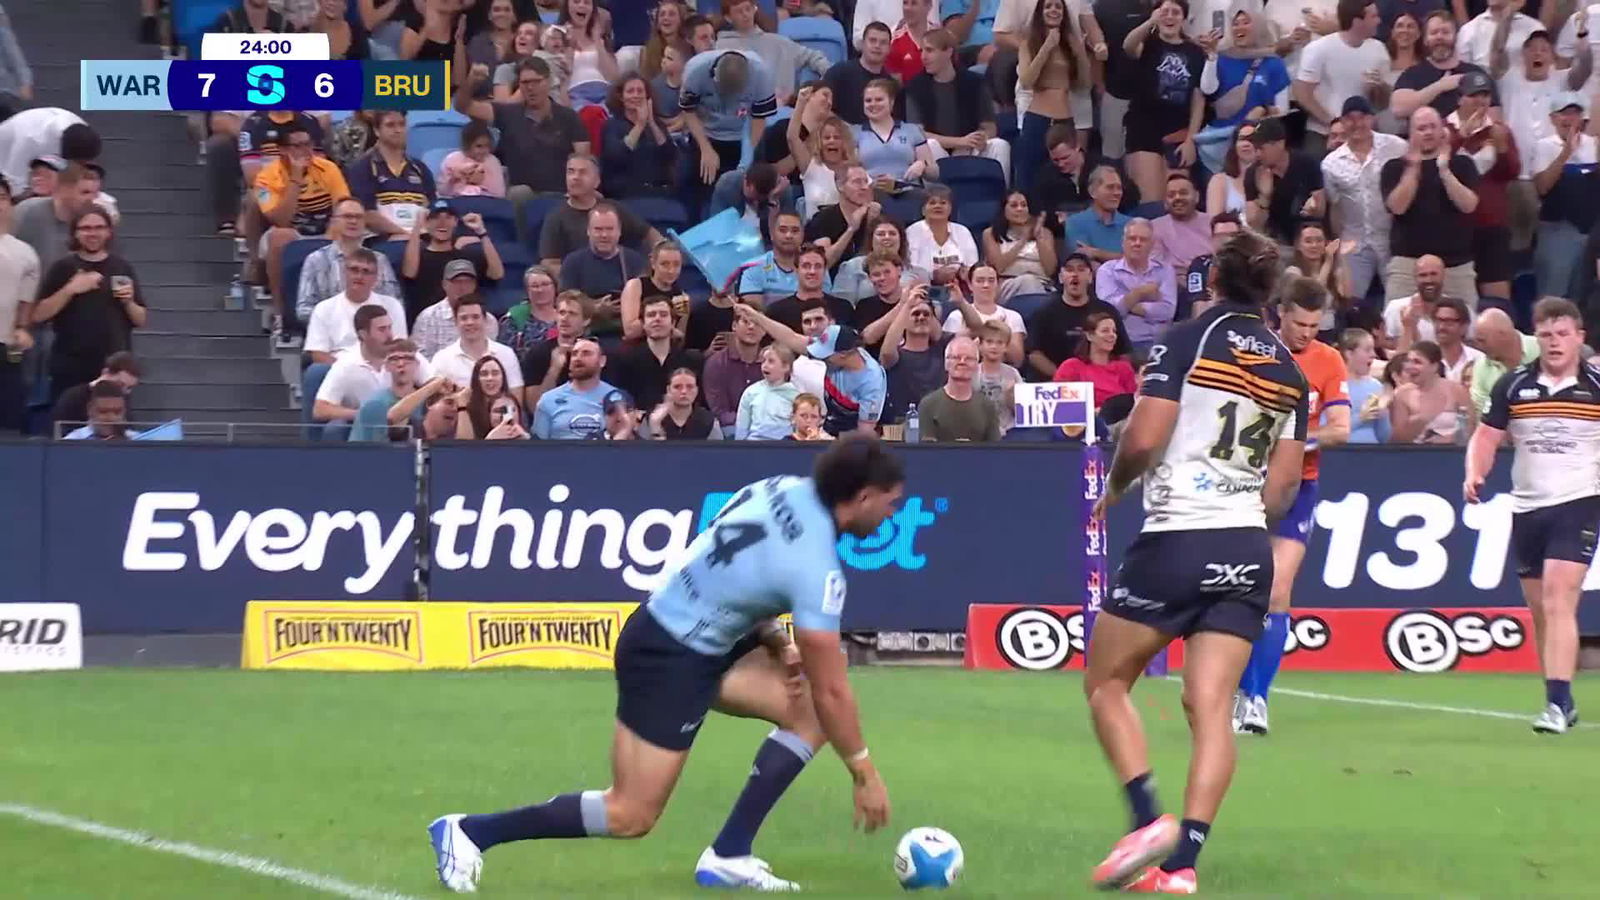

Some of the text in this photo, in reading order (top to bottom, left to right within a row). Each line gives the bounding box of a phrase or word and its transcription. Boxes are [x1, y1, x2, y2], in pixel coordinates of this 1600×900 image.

[1035, 386, 1079, 400] FedEx
[1022, 401, 1058, 425] TRY
[1210, 400, 1276, 468] 14
[1084, 459, 1099, 500] FedEx
[1087, 570, 1102, 612] FedEx
[341, 618, 412, 651] TWENTY
[543, 618, 613, 651] TWENTY
